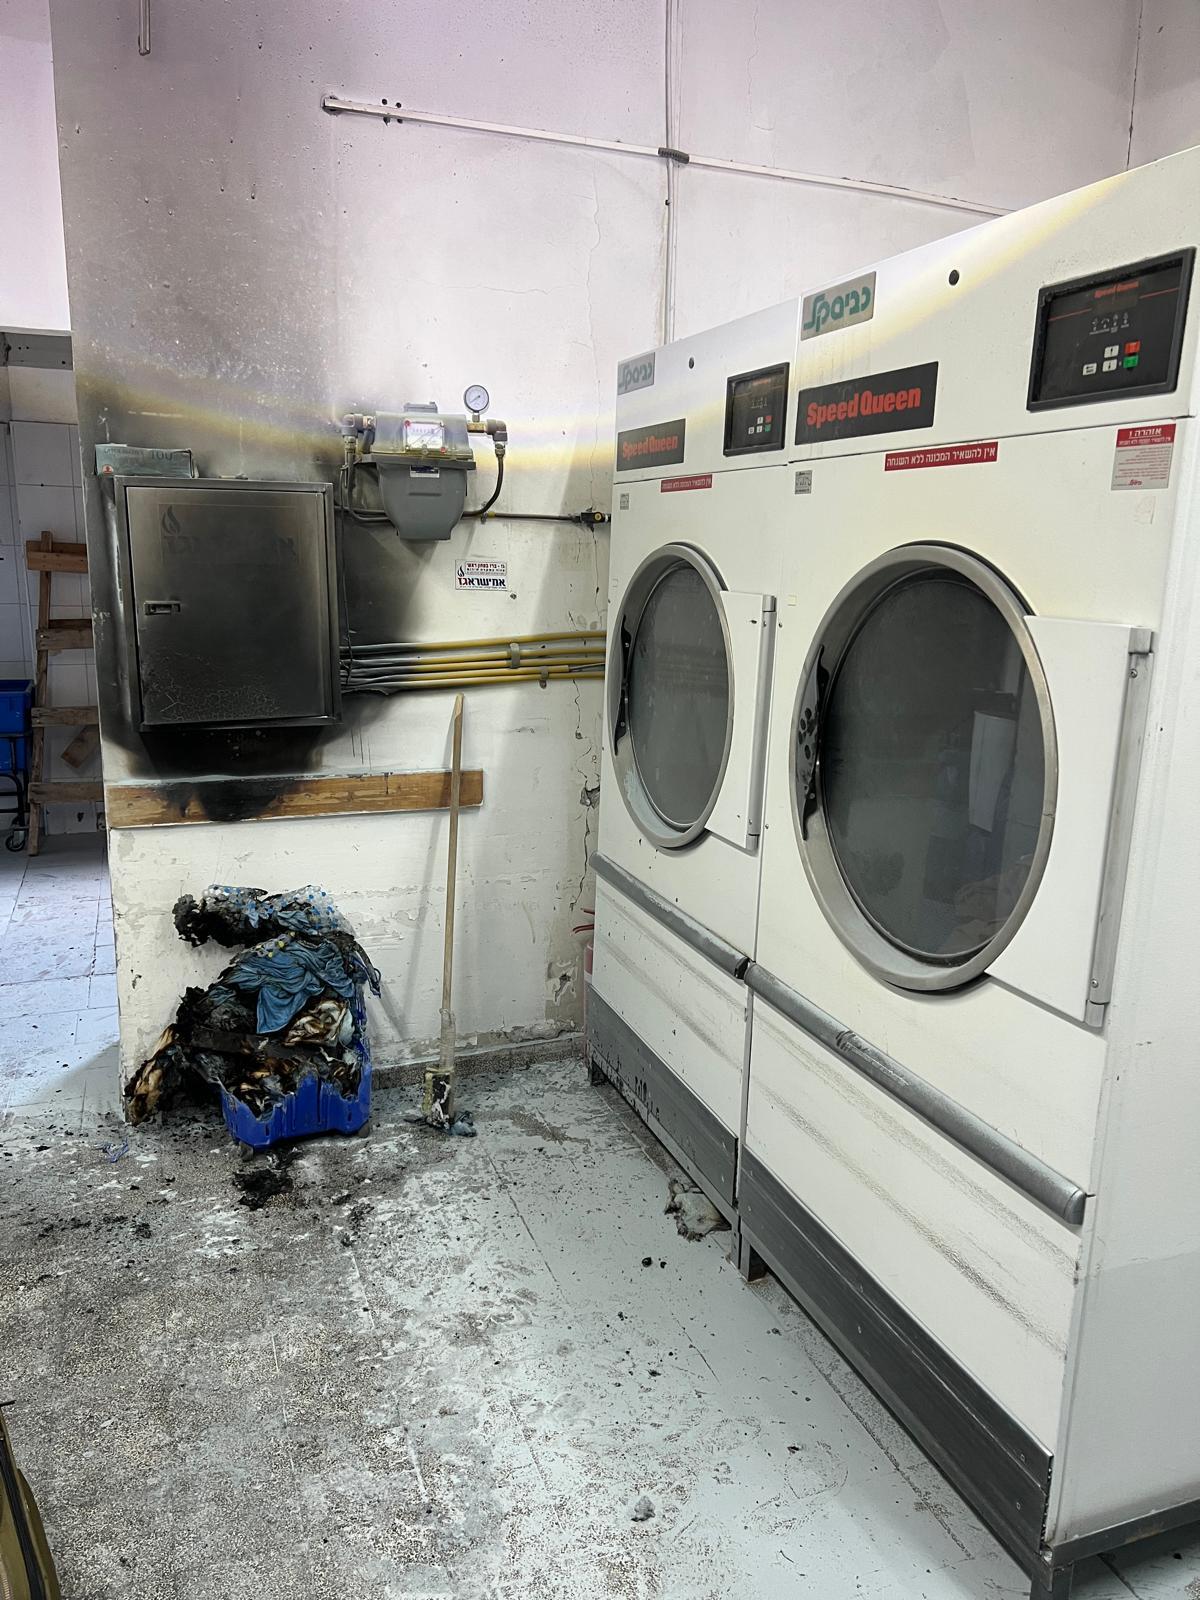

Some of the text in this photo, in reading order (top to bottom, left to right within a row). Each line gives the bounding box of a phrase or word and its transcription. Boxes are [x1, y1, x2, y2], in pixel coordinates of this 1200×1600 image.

[806, 387, 921, 429] Speed Queen
[623, 435, 678, 459] Speed Queen
[886, 447, 995, 467] אין להשאיר המכונה ללא השגחה
